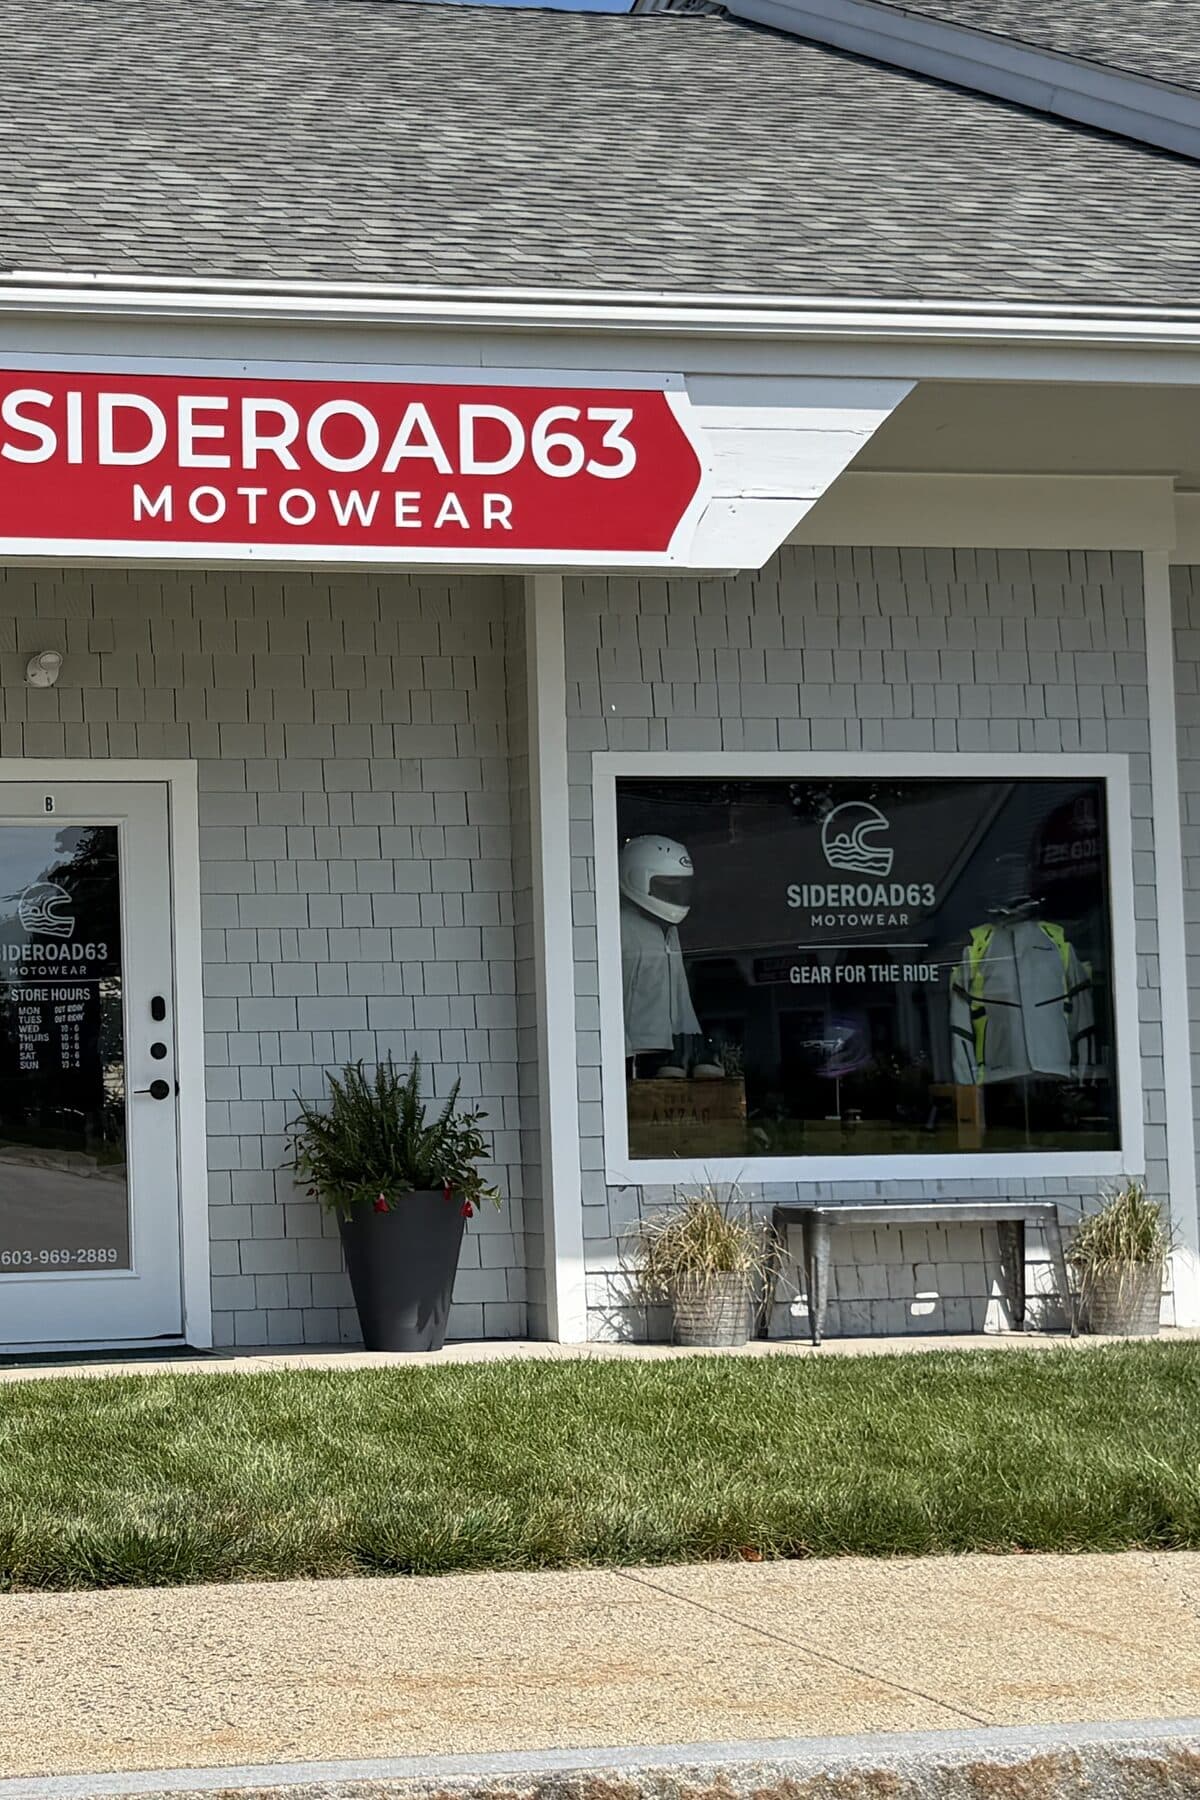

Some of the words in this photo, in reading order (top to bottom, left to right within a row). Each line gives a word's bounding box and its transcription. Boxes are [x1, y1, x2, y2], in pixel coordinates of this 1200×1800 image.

[0, 388, 637, 479] SIDEROAD63
[133, 484, 513, 530] MOTOWEAR
[45, 796, 54, 812] B
[786, 883, 936, 908] SIDEROAD63
[811, 914, 909, 927] MOTOWEAR
[9, 965, 87, 976] MOTOWEAR
[790, 966, 832, 984] GEAR
[835, 965, 866, 983] FOR
[868, 965, 900, 982] THE
[903, 965, 939, 982] RIDE
[11, 988, 48, 1002] STORE
[50, 988, 91, 1001] HOURS
[18, 1006, 40, 1015] MON
[18, 1015, 42, 1024] TUES
[18, 1024, 40, 1033] WED
[18, 1033, 50, 1042] THURS
[19, 1042, 34, 1051] FRI
[19, 1052, 36, 1060] SAT
[19, 1060, 39, 1070] SUN
[0, 1248, 118, 1265] 603-969-2889
